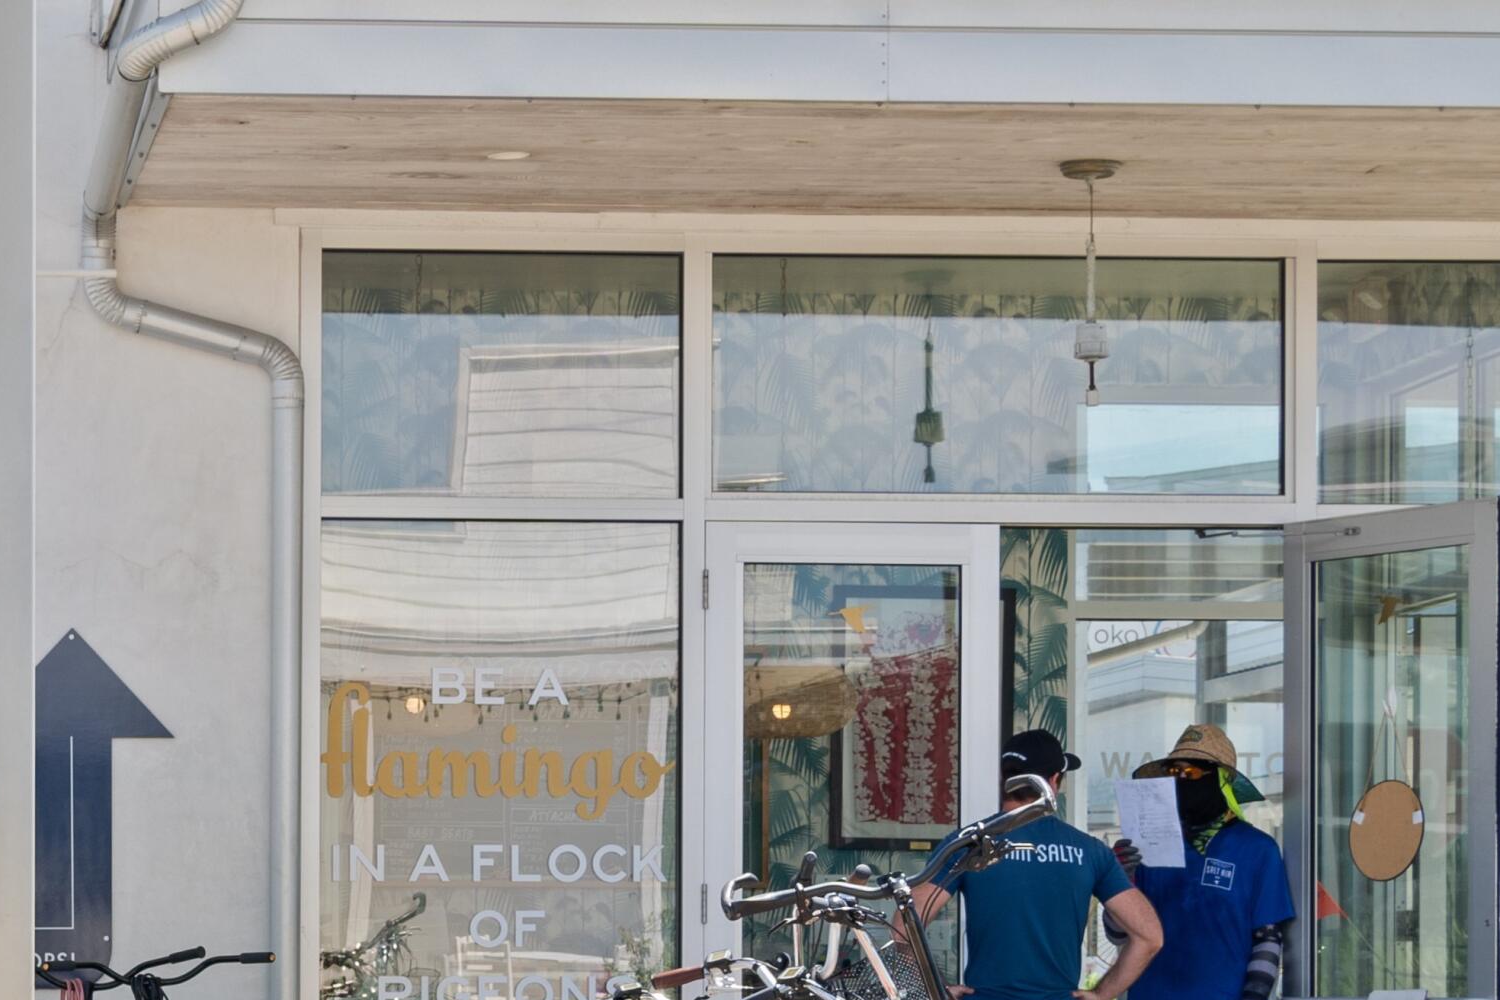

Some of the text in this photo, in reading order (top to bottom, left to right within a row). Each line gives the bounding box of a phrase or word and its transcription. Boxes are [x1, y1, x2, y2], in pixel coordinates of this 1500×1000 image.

[431, 667, 569, 705] BE A
[320, 681, 676, 820] flamingo
[331, 843, 667, 883] IN A FLOCK
[1036, 843, 1084, 866] SALTY
[469, 909, 546, 948] OF
